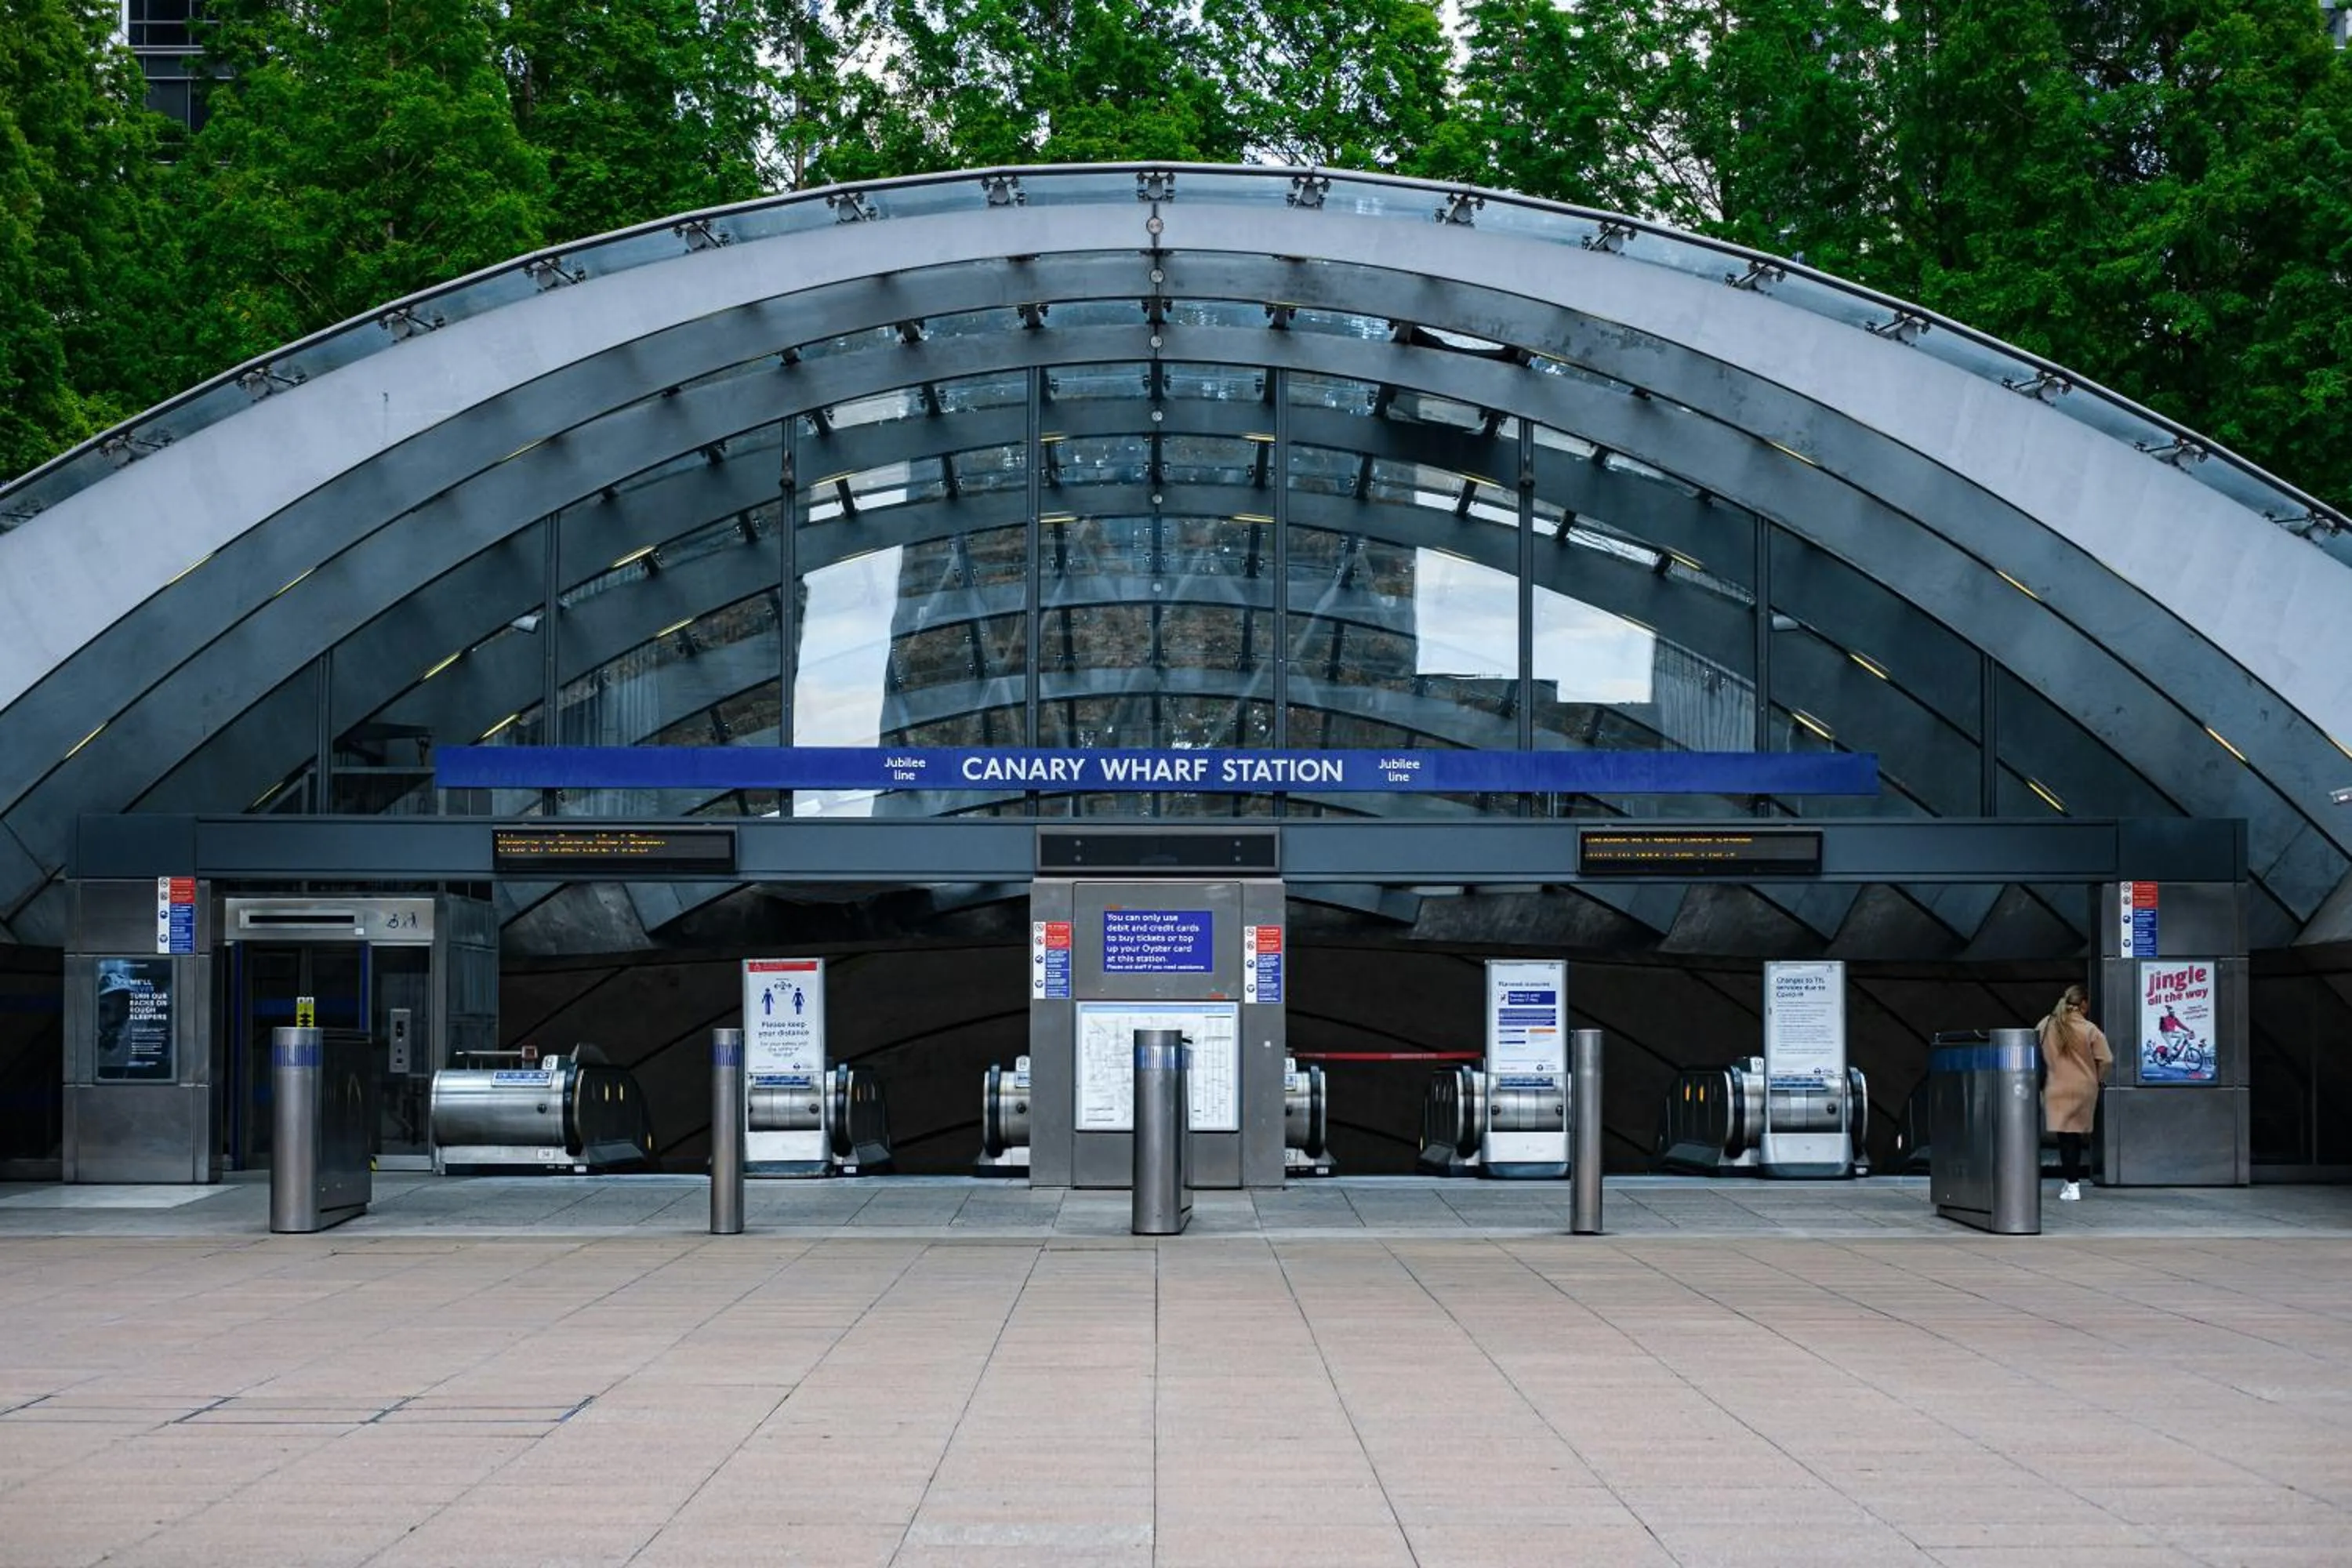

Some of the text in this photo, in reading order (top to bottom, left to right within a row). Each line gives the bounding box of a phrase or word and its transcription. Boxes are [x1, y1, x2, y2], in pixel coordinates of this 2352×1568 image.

[884, 757, 926, 768] Jubilee
[1379, 758, 1421, 770] Jubilee
[962, 757, 1343, 782] CANARY WHARF STATION
[894, 770, 916, 781] line
[1388, 771, 1410, 782] line
[1142, 913, 1160, 923] only
[1119, 935, 1134, 943] buy
[1142, 944, 1171, 953] Oyster
[2148, 988, 2208, 1005] all the way
